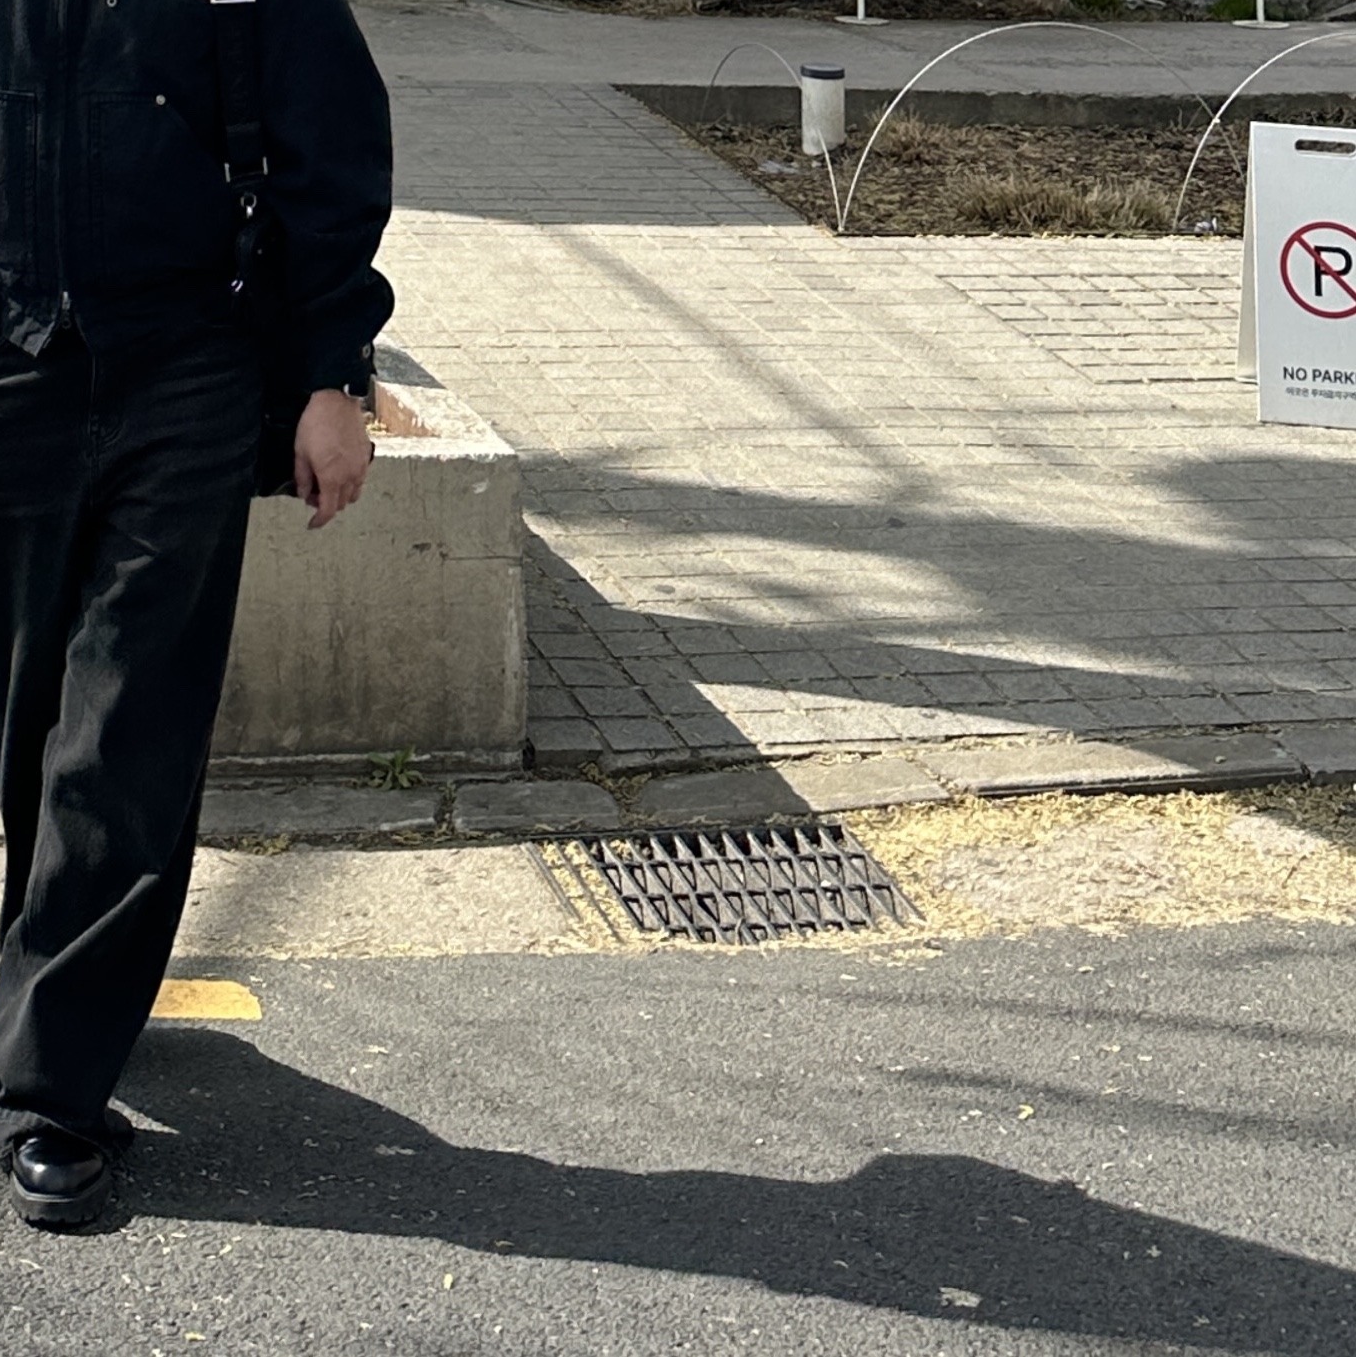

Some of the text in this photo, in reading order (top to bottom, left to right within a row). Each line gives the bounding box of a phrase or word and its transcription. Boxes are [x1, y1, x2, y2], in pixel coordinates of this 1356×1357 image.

[1314, 245, 1352, 296] P
[1283, 366, 1356, 385] NO PARK
